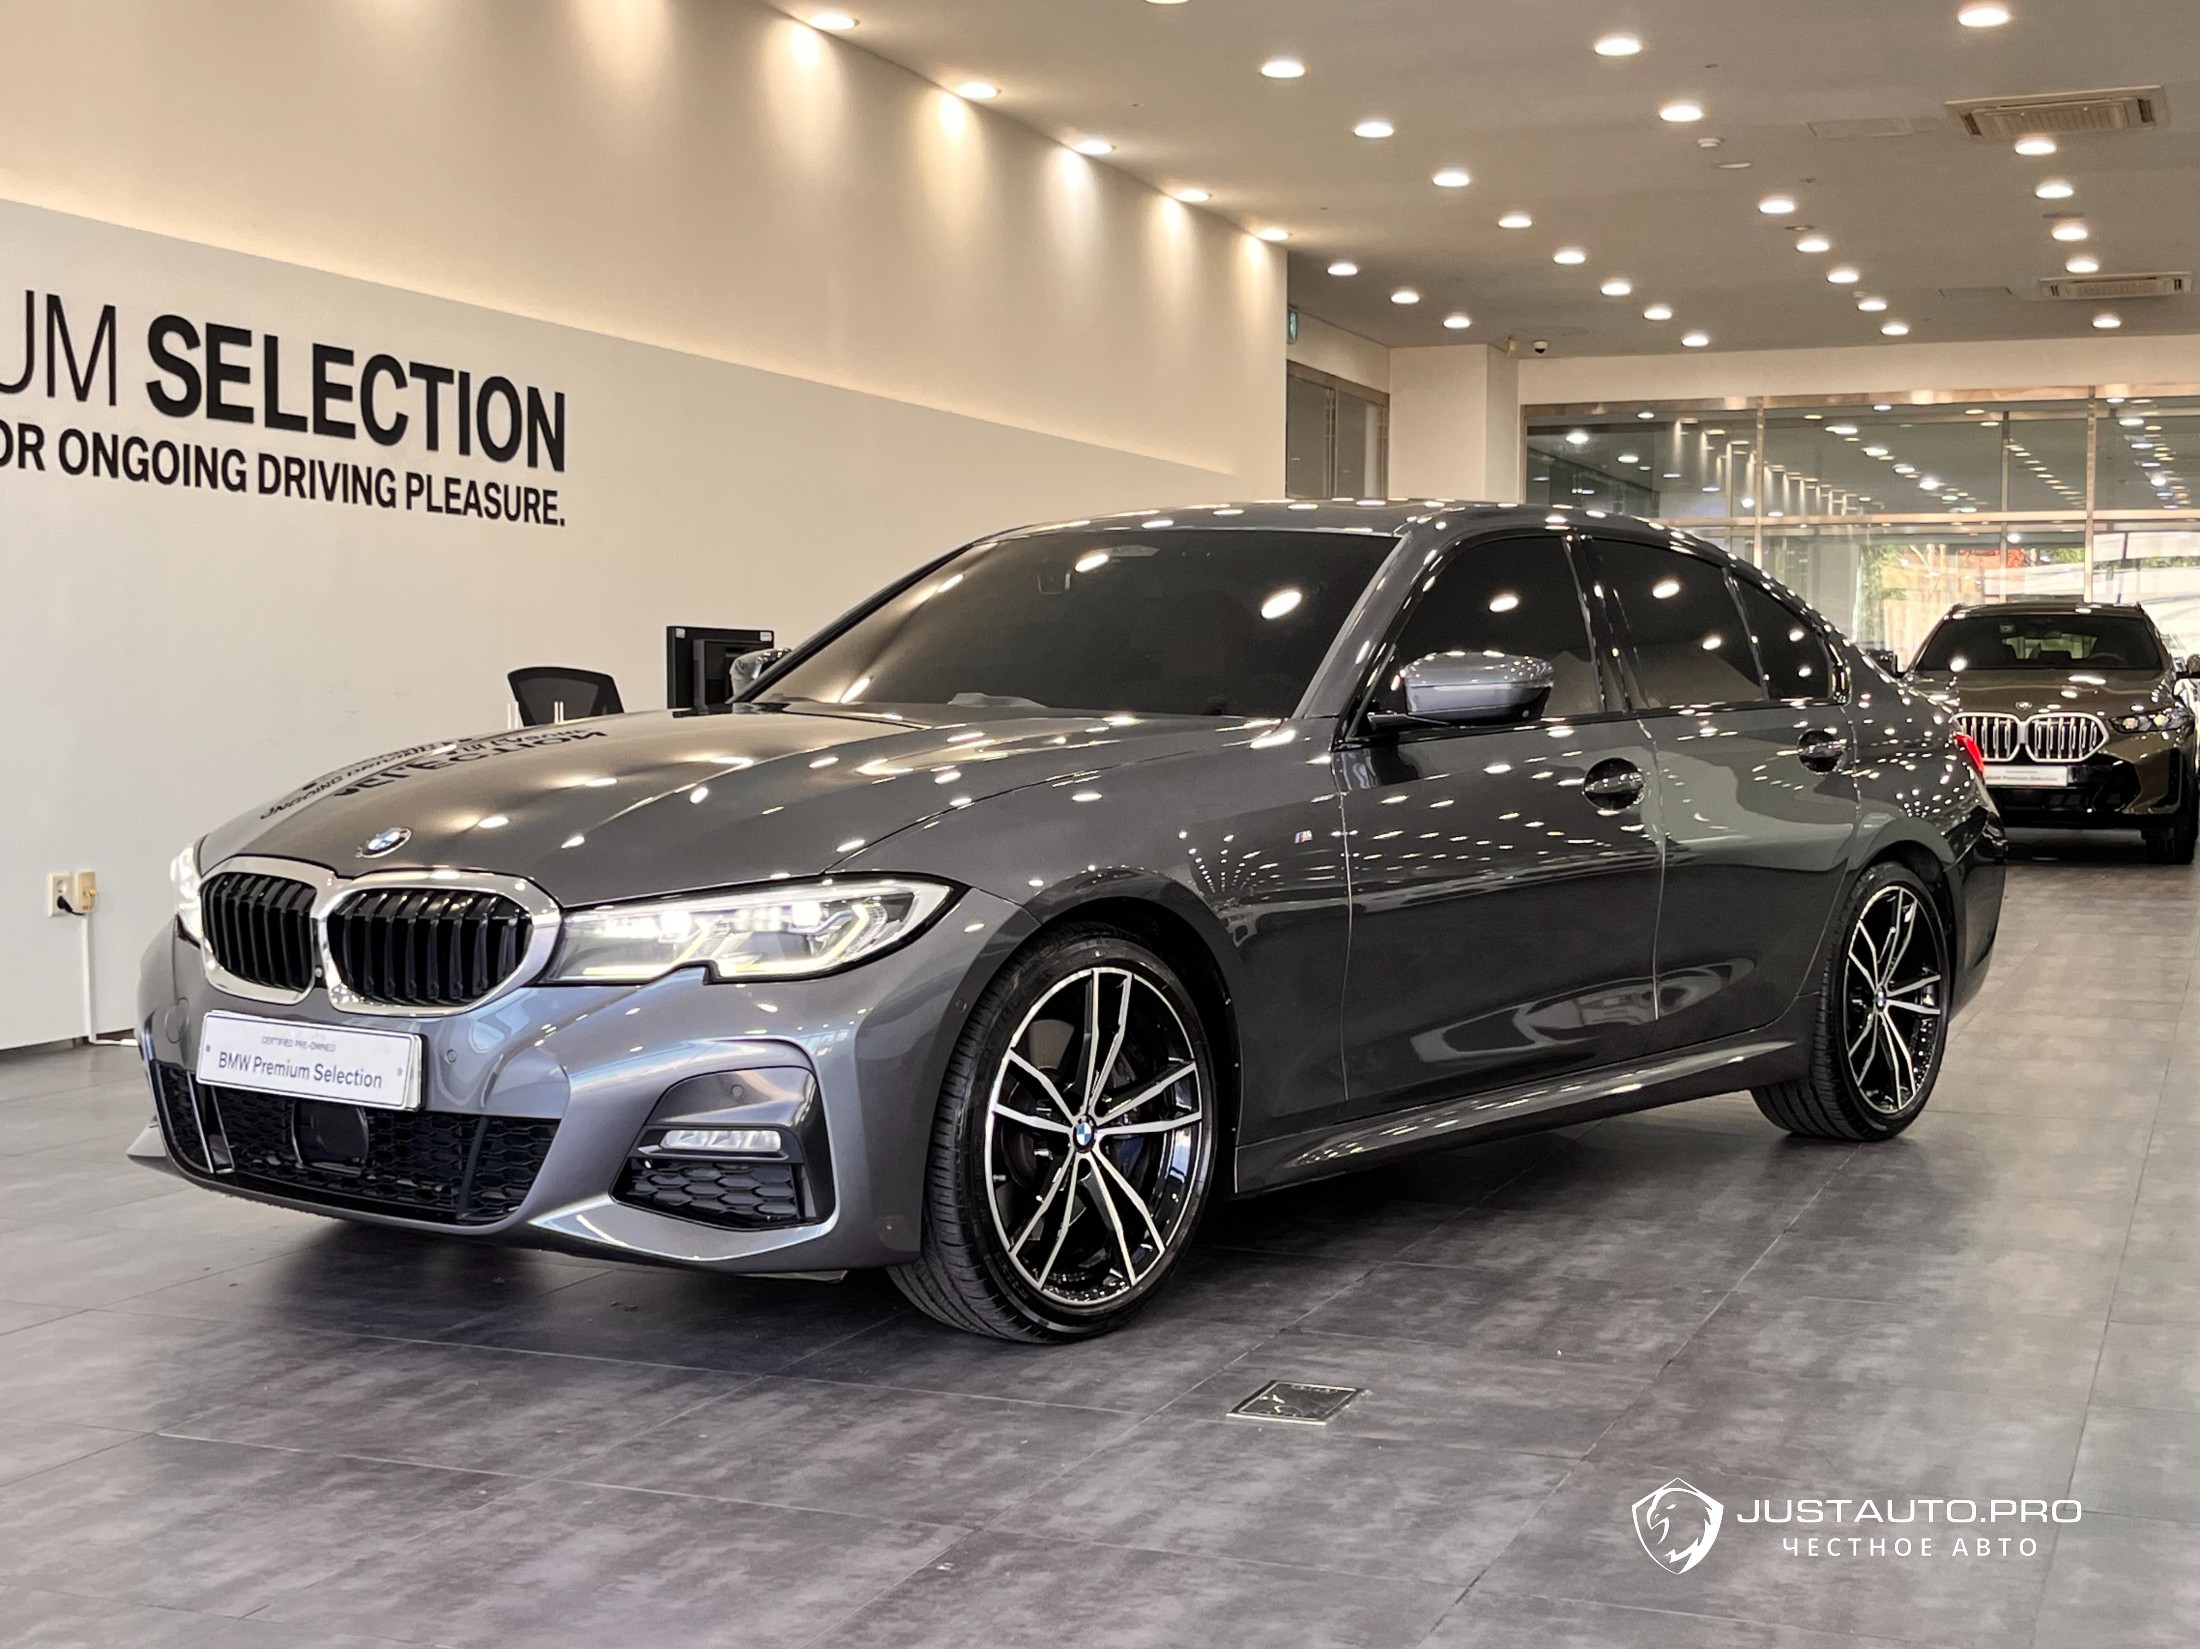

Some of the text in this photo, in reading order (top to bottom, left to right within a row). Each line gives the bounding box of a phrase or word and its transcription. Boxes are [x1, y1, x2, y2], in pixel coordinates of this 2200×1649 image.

[145, 314, 566, 473] SELECTION
[58, 428, 247, 493] ONGOING
[258, 452, 397, 509] DRIVING
[406, 471, 566, 527] PLEASURE.
[218, 1051, 383, 1089] BMW Premium Selection
